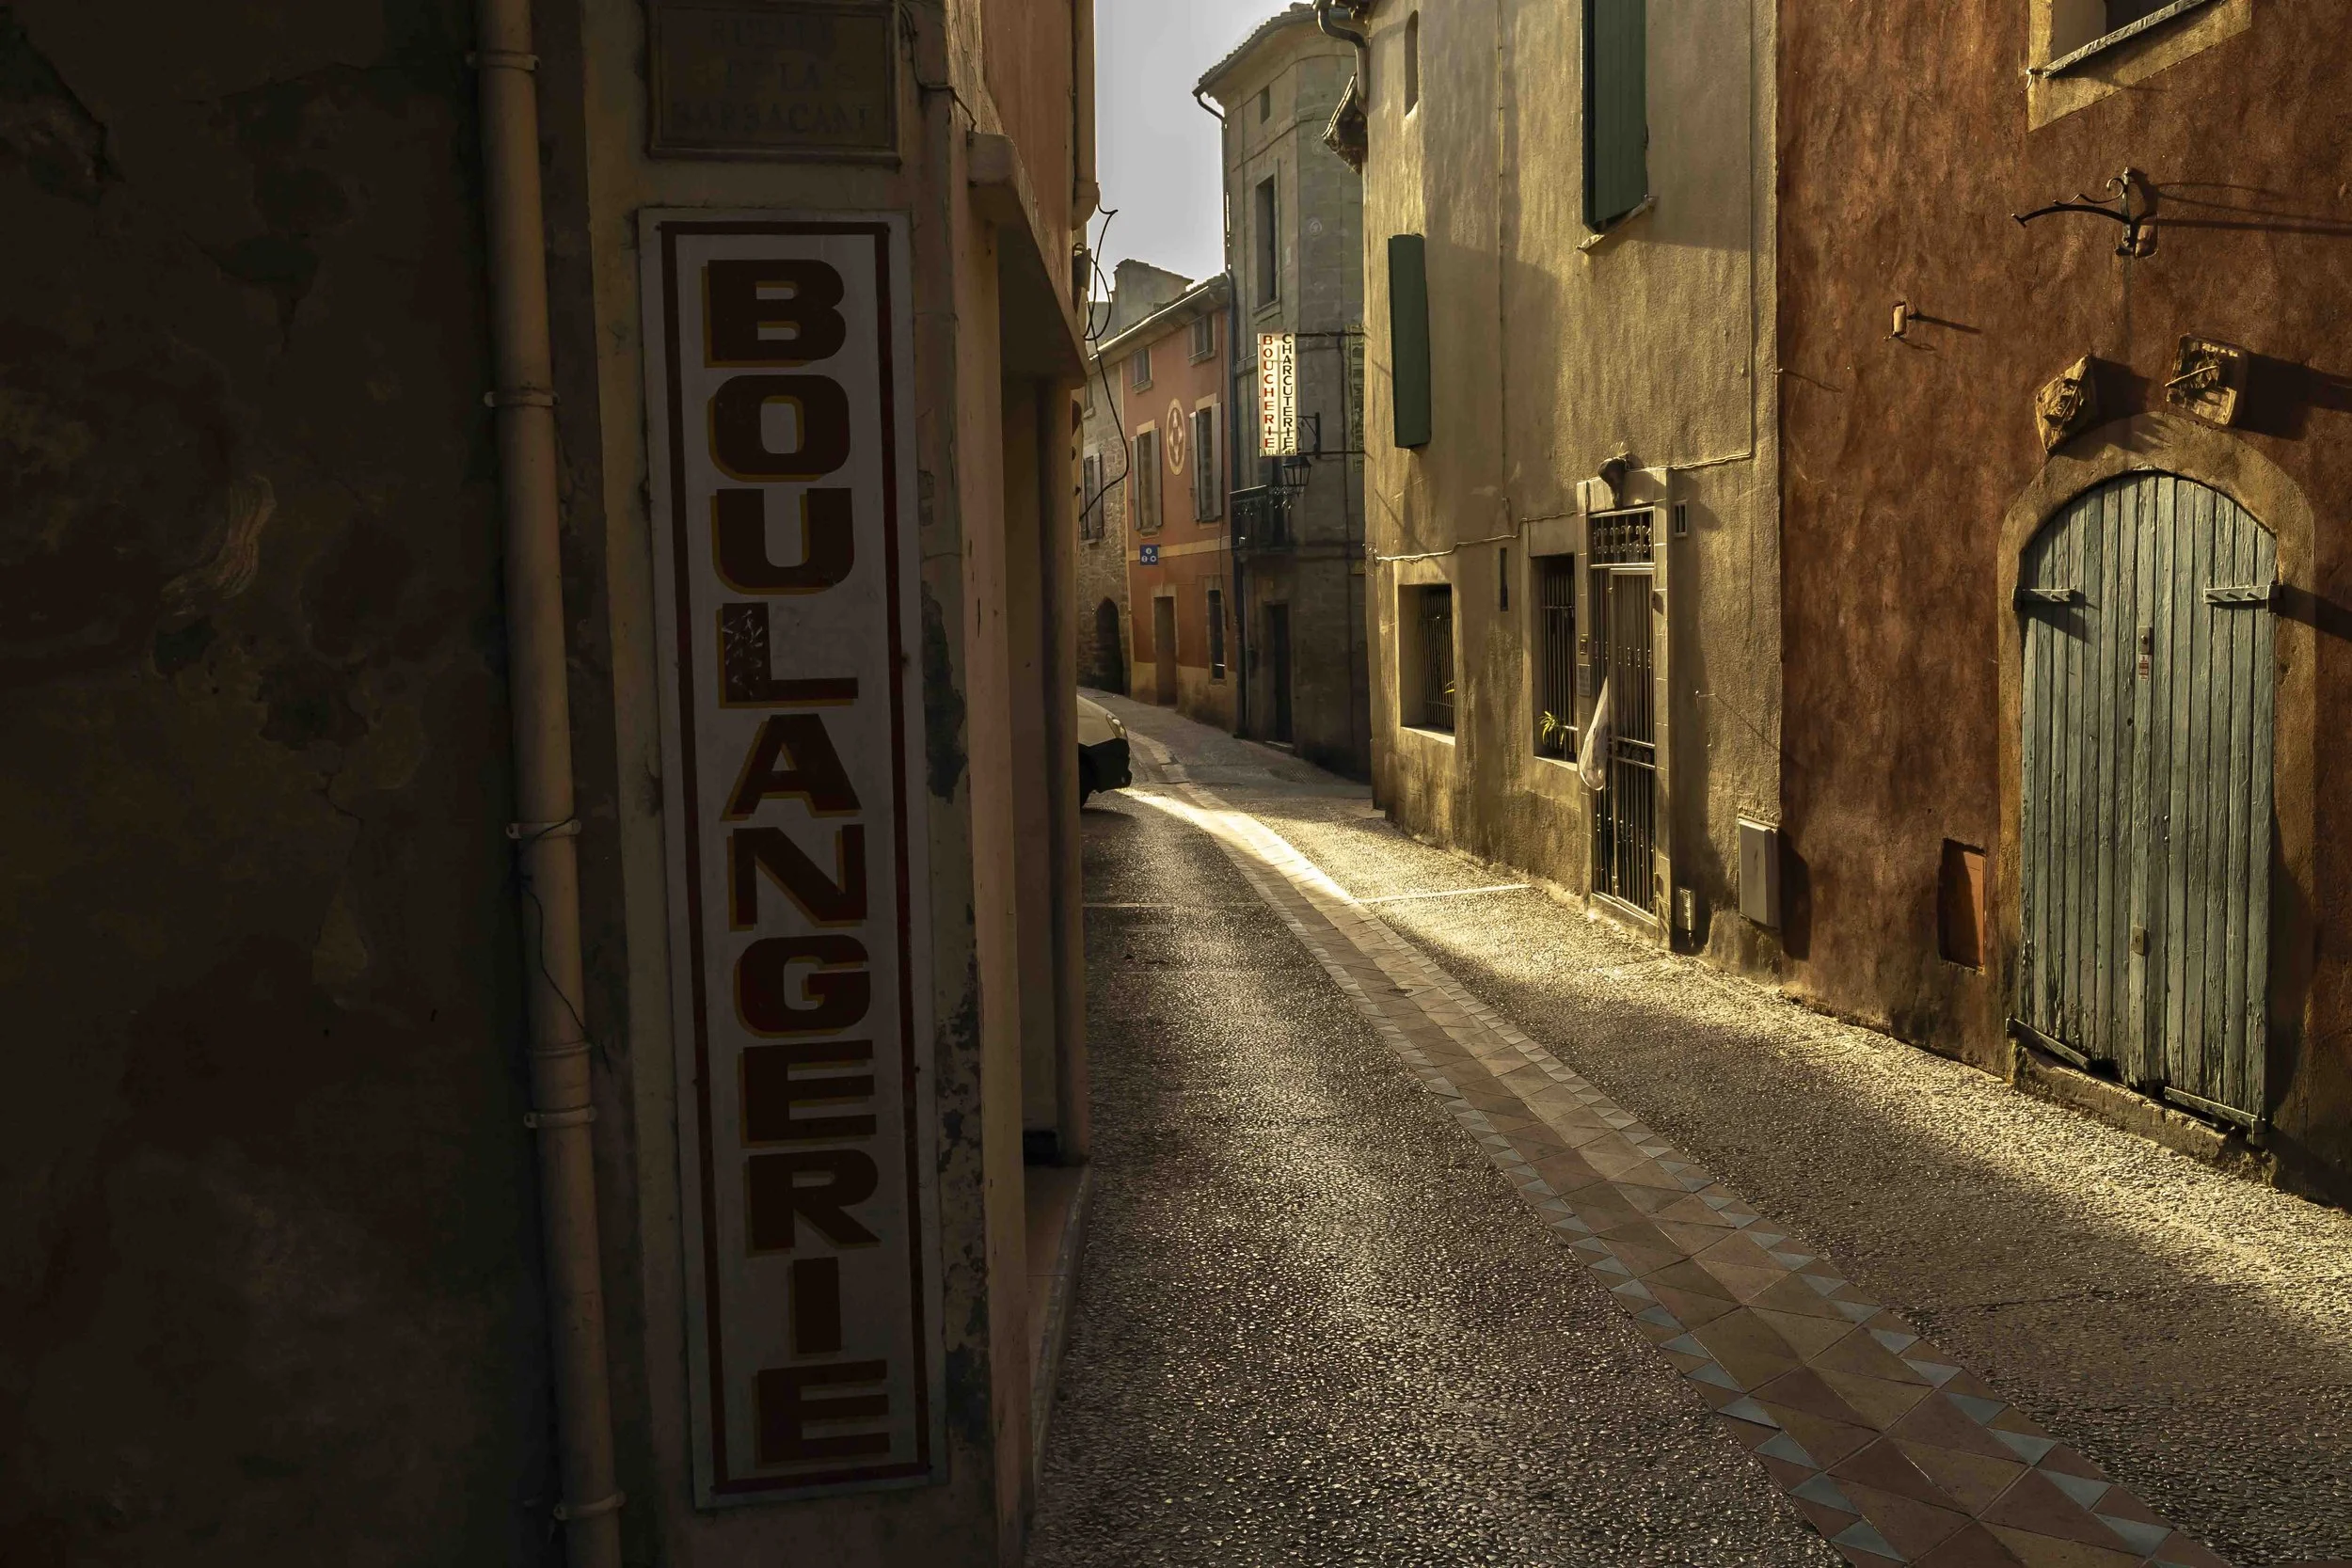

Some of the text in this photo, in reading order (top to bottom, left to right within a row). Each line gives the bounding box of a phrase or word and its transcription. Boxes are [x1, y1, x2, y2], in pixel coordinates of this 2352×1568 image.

[1263, 335, 1275, 448] BOUCHERIE
[1282, 334, 1293, 449] CHARCUTERIE
[703, 260, 890, 1467] BOULANGERIE
